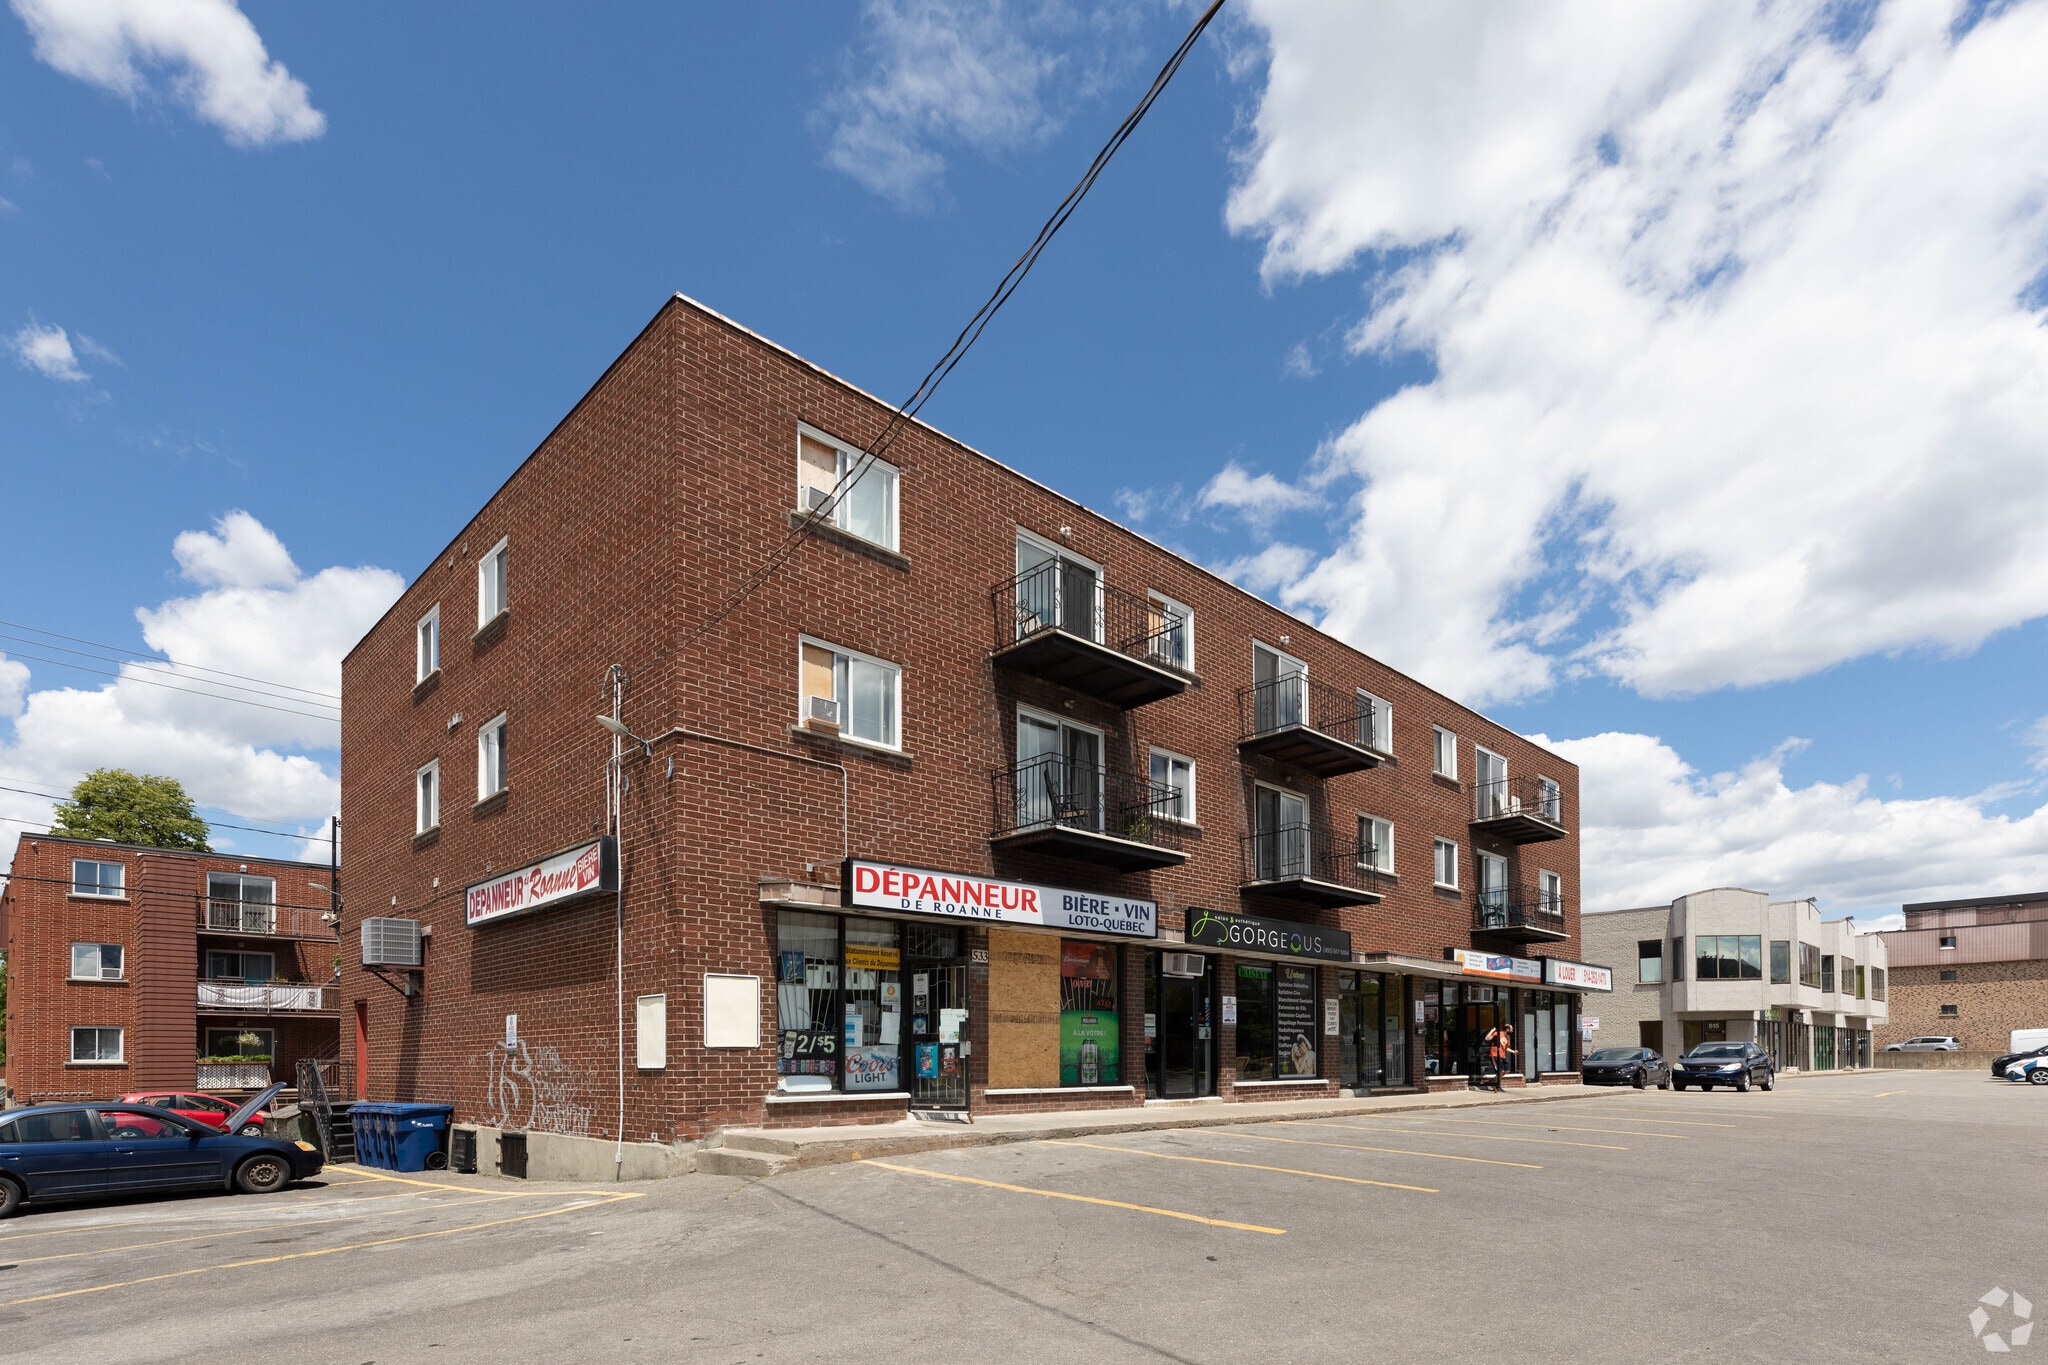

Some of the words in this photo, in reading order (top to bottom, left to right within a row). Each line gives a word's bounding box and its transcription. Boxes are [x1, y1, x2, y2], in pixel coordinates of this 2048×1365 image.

[529, 865, 577, 903] Roanne
[582, 865, 595, 883] VIN
[856, 867, 1038, 913] DÉPANNEUR
[901, 898, 923, 910] DE
[934, 901, 1003, 919] ROANNE
[1063, 895, 1109, 916] BIÈRE
[1124, 903, 1150, 921] VIN
[1069, 914, 1145, 933] LOTO-QUÉBEC
[1229, 925, 1322, 953] GORGEOUS
[972, 951, 988, 961] 533
[844, 1053, 894, 1074] Coors
[855, 1073, 886, 1083] LIGHT
